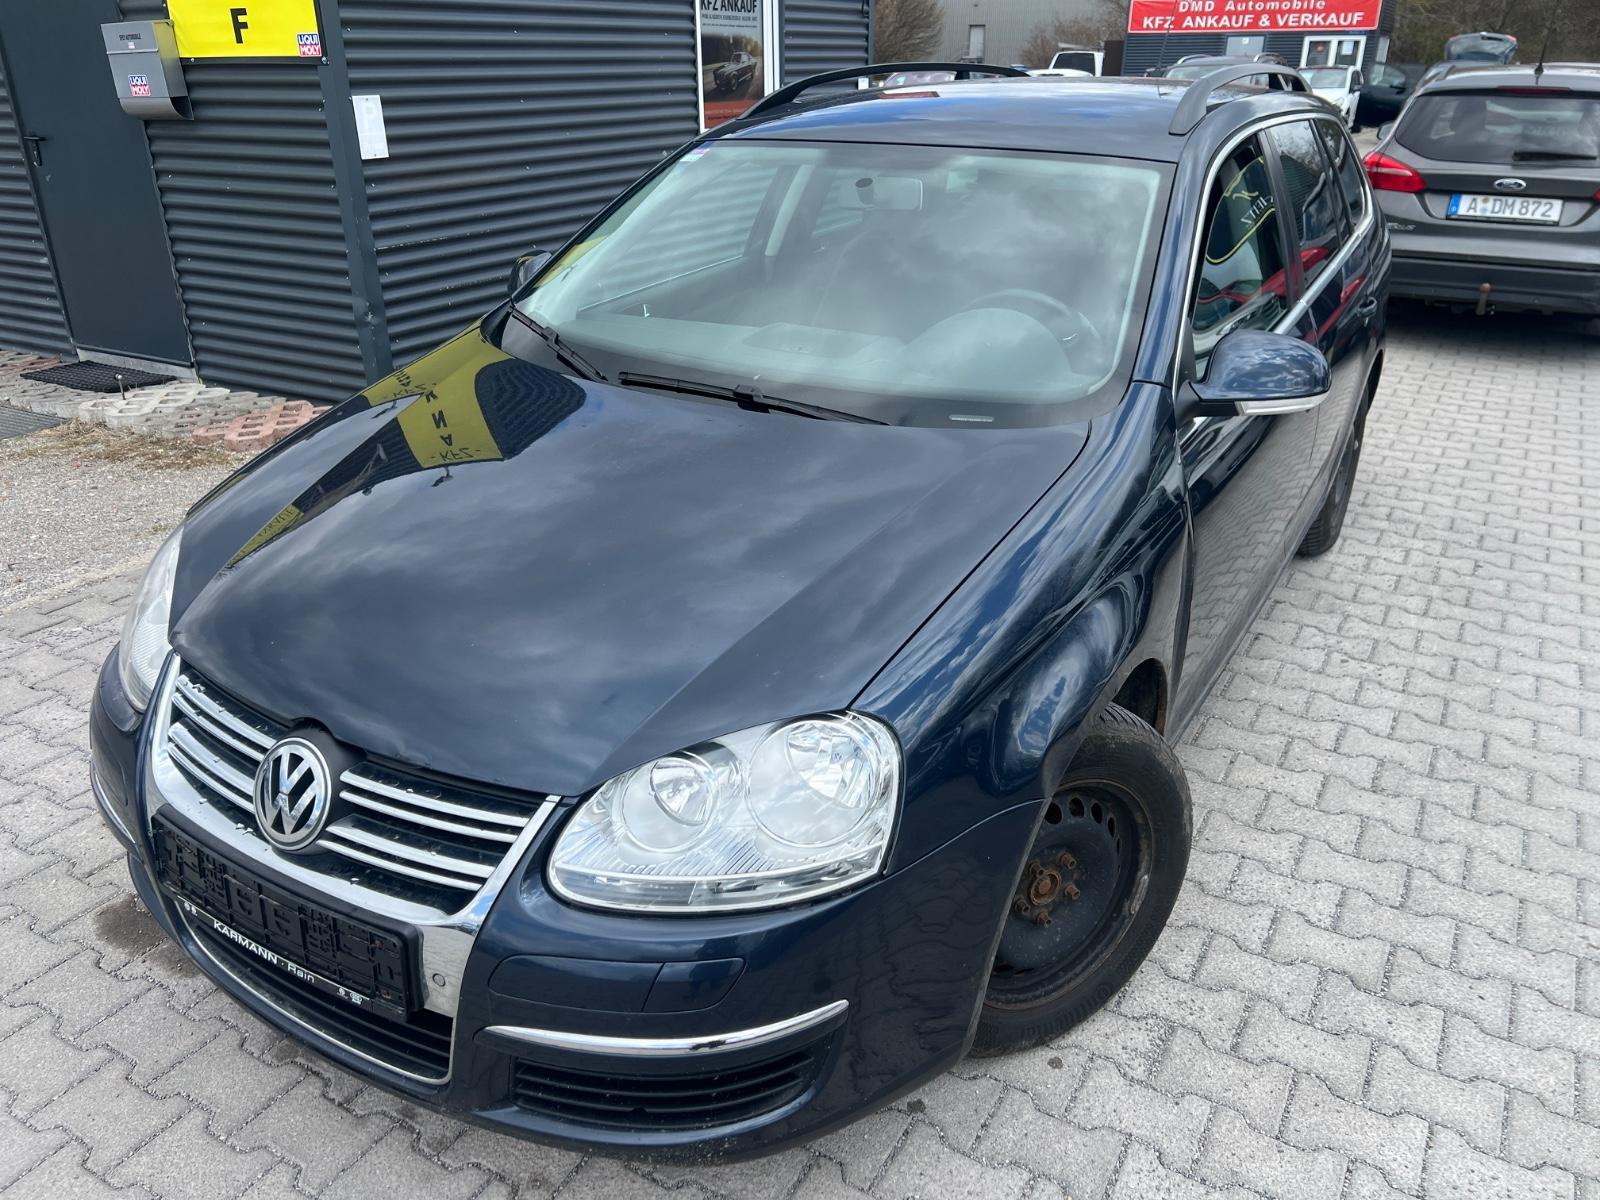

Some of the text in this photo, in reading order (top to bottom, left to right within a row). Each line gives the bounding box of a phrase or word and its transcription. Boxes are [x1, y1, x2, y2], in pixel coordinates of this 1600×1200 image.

[700, 0, 757, 13] KFZ ANKAUF
[1178, 0, 1326, 12] DMD Automobile
[230, 8, 249, 44] F
[1143, 17, 1174, 29] KFZ
[1182, 14, 1254, 29] ANKAUF
[1276, 12, 1365, 27] VERKAUF
[298, 34, 319, 45] LIQUI
[300, 45, 320, 55] MOLY
[1467, 199, 1552, 219] A DM 872
[213, 918, 315, 984] KARMANN Rain
